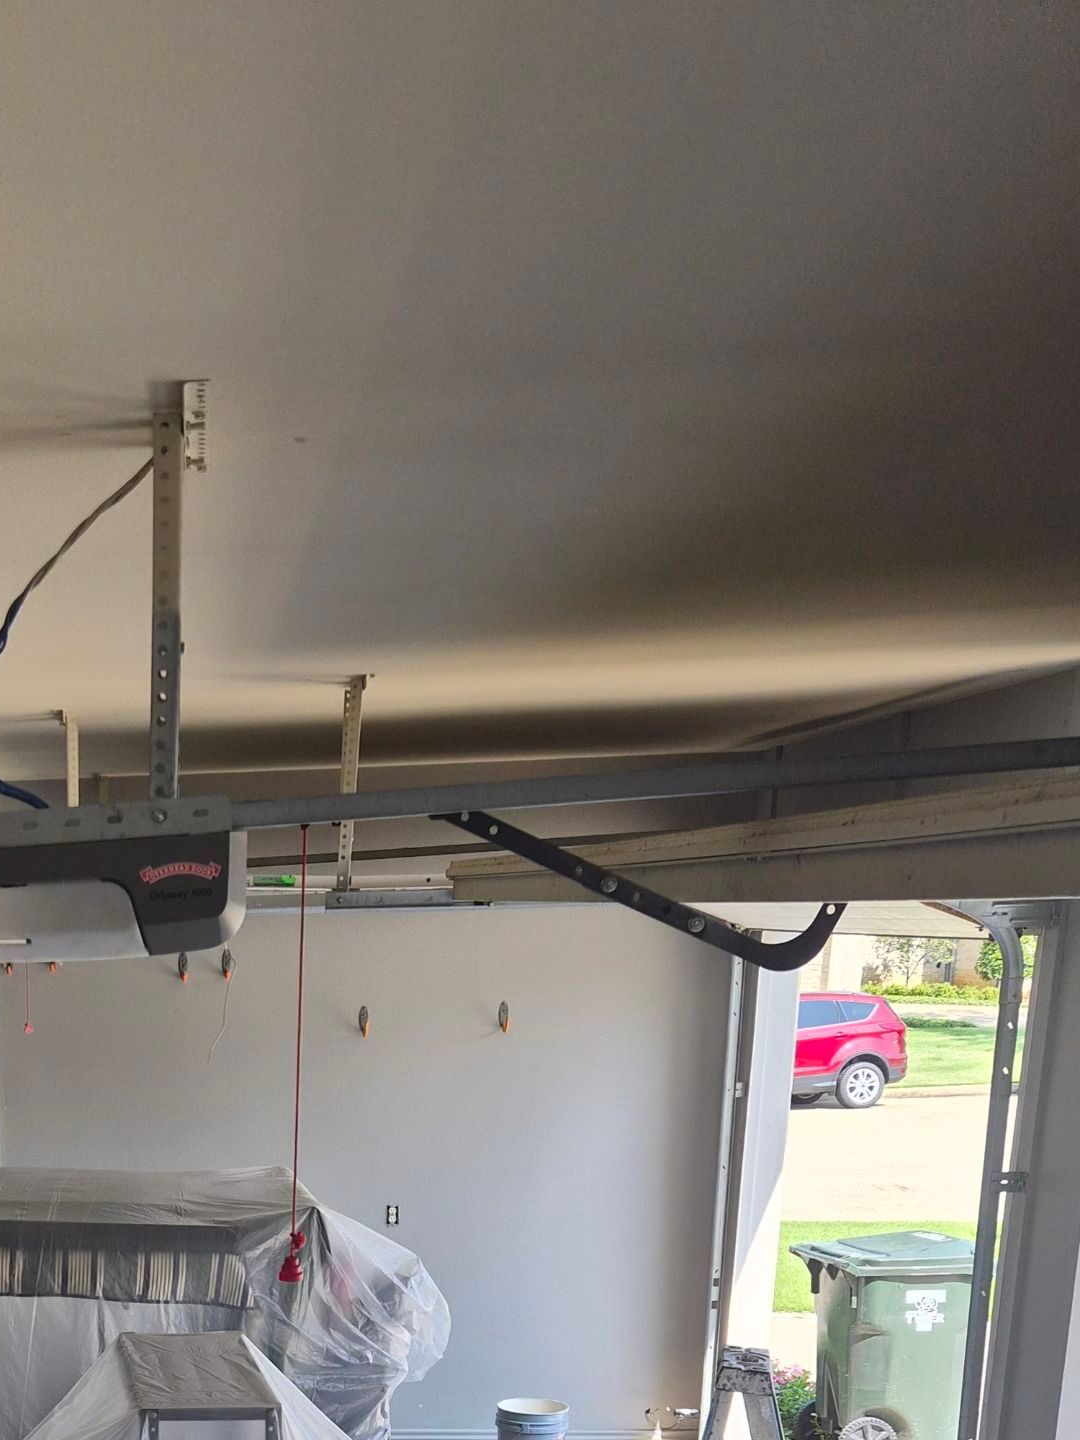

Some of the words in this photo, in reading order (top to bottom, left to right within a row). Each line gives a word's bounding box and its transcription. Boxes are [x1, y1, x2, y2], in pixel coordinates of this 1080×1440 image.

[149, 864, 190, 880] OVERHEAD
[192, 864, 213, 877] DOOR
[148, 889, 189, 901] Odyssey
